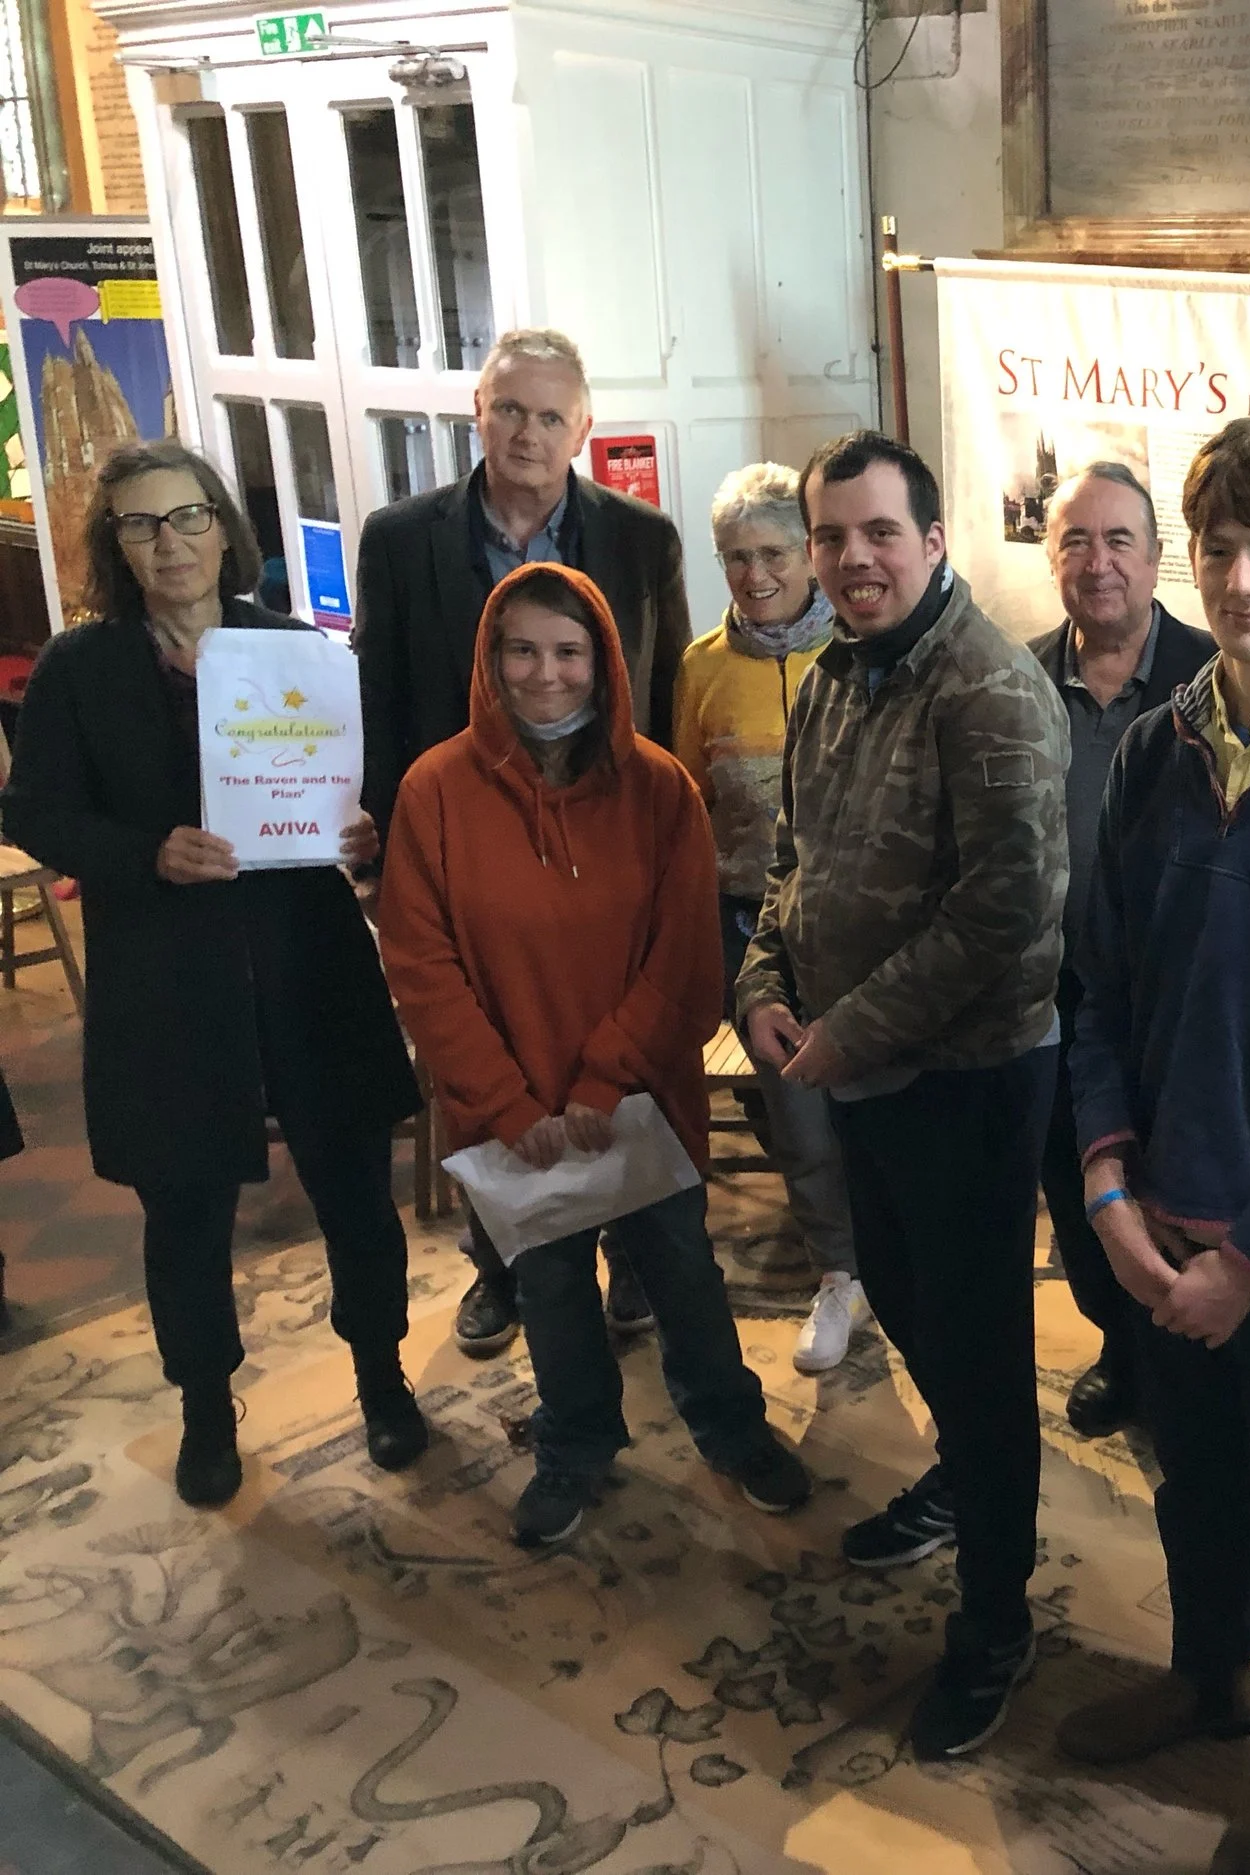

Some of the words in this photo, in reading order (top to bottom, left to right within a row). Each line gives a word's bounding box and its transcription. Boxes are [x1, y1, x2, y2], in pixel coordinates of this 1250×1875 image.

[86, 242, 113, 255] Joint
[116, 242, 153, 257] appeal
[214, 717, 347, 743] Congratulations!
[254, 775, 298, 785] Raven
[301, 775, 327, 785] and
[331, 775, 351, 785] the
[258, 821, 321, 837] AVIVA
